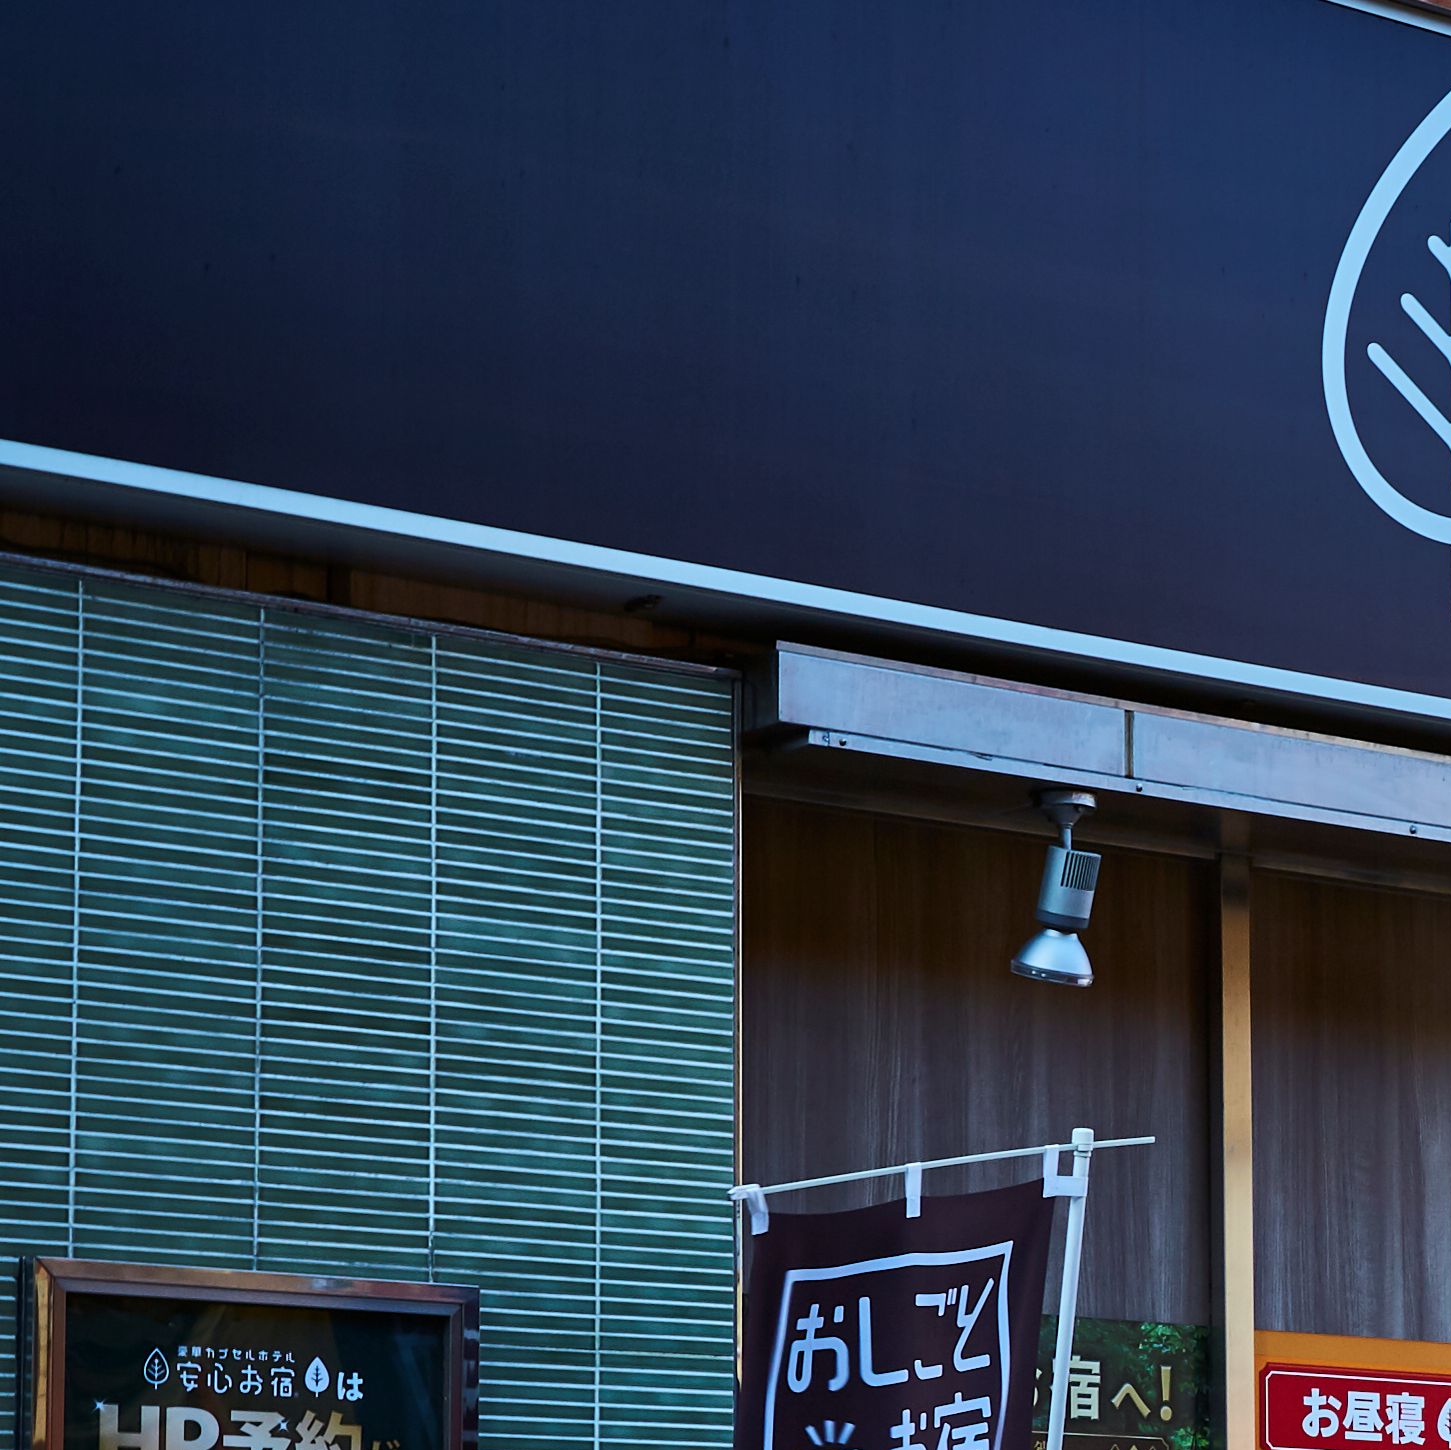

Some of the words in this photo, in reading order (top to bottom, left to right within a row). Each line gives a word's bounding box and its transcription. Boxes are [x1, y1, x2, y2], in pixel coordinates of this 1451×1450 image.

[788, 1278, 994, 1393] おしごと
[337, 1372, 363, 1401] は
[1302, 1388, 1425, 1446] お昼寝
